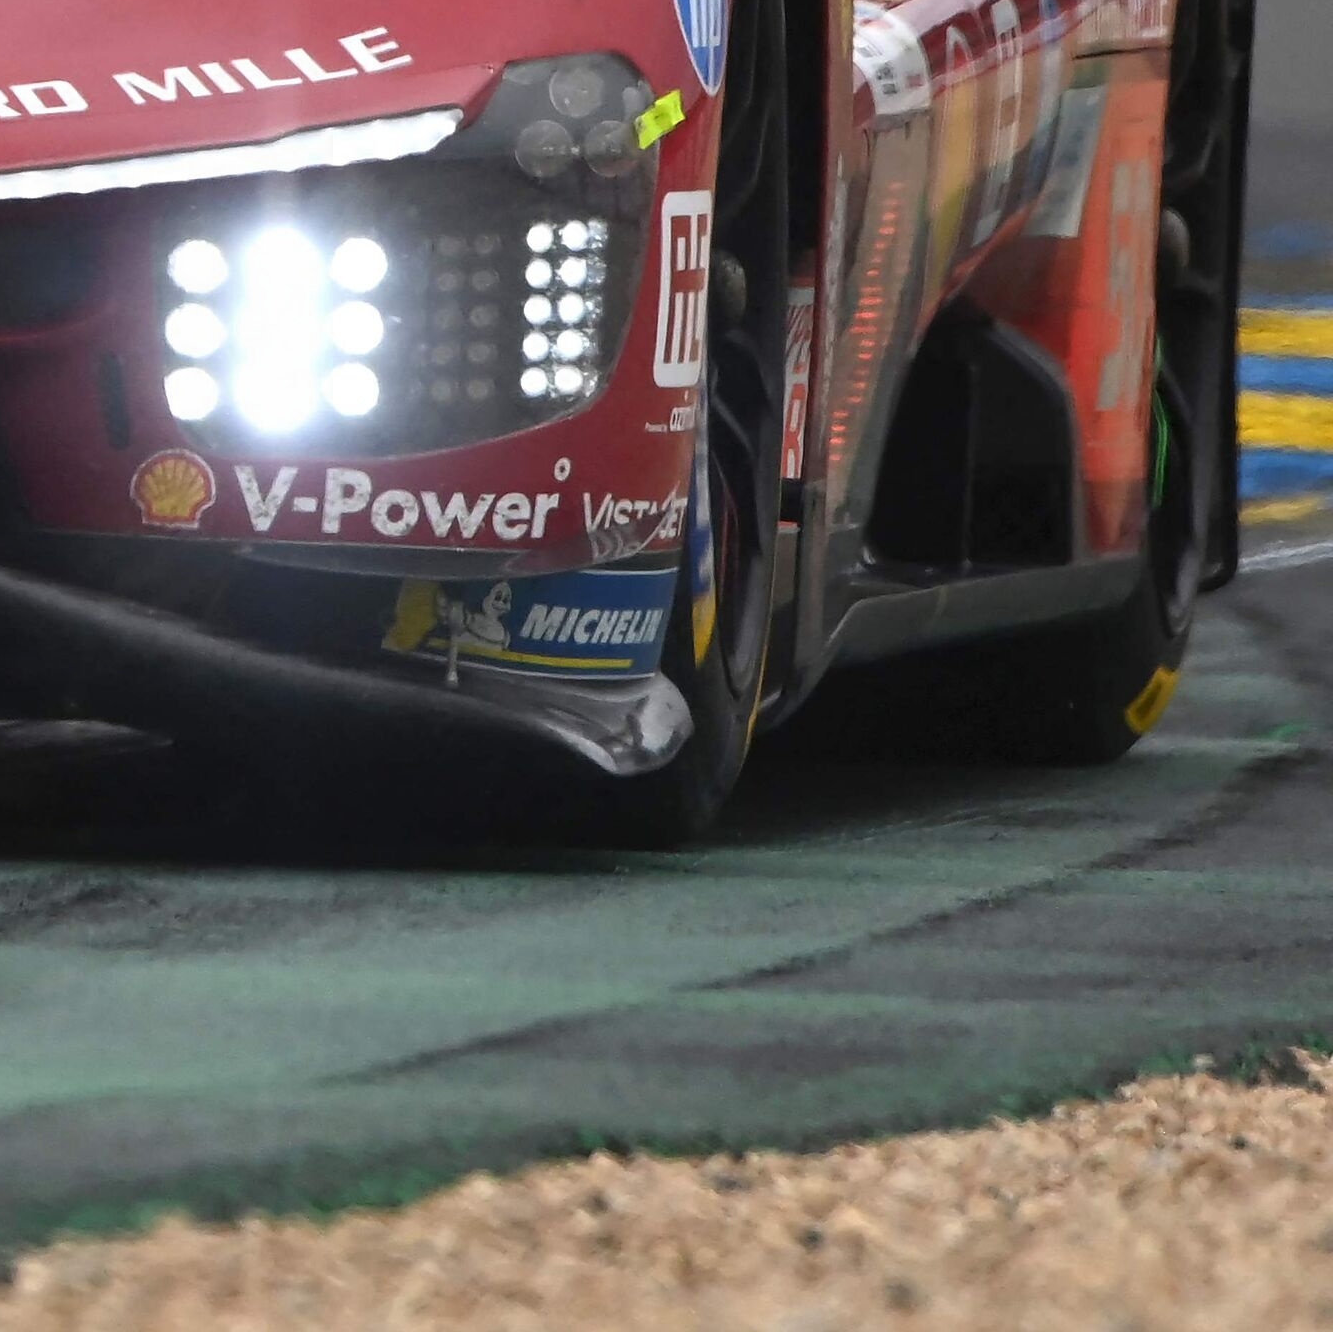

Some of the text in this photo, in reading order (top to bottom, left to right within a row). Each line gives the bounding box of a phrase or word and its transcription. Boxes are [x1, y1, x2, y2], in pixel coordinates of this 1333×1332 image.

[111, 25, 414, 105] MILLE
[234, 465, 561, 541] V-Power
[520, 602, 664, 645] MICHELIN
